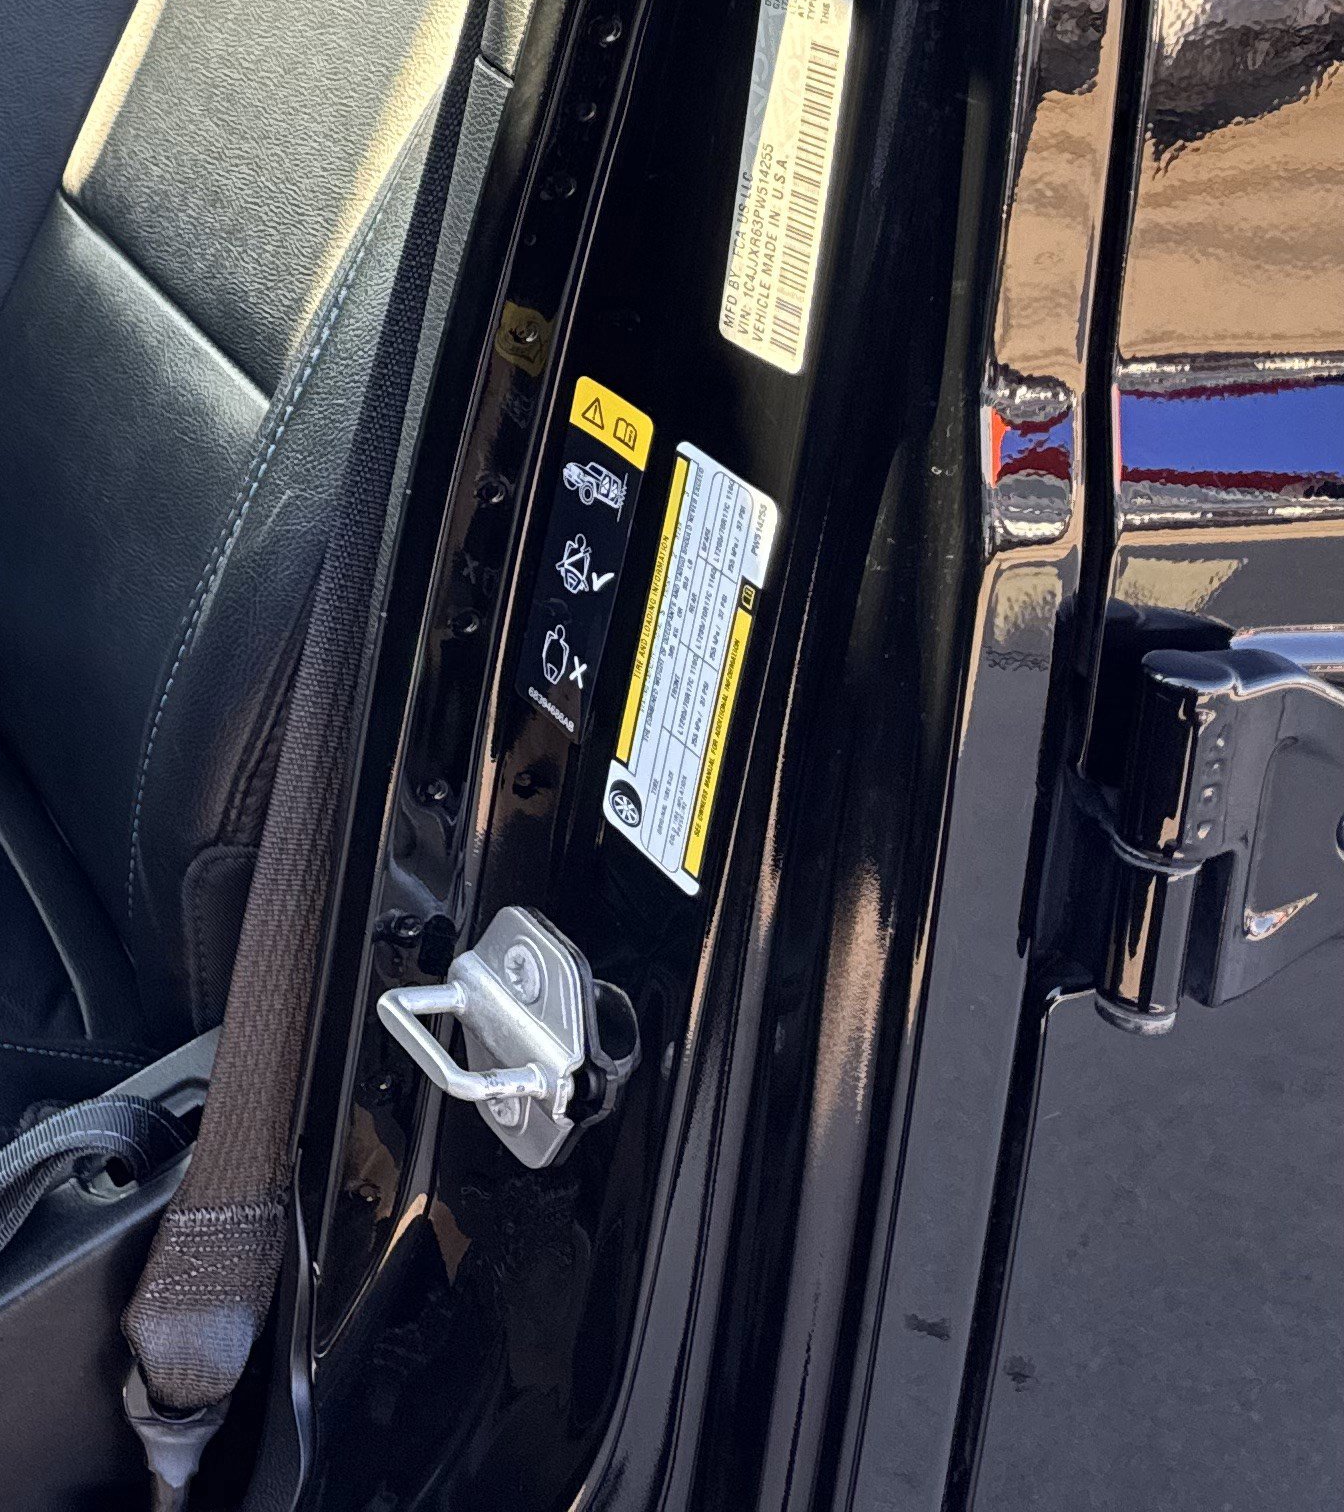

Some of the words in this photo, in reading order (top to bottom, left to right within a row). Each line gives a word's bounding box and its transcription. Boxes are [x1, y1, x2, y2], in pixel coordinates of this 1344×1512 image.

[797, 5, 805, 18] AT
[819, 1, 830, 25] THIS
[739, 169, 753, 200] LLC
[736, 202, 750, 225] US
[742, 140, 774, 301] 1C4JJXR63PW514255
[732, 227, 746, 259] FCA
[760, 230, 778, 277] MADE
[723, 293, 738, 329] MFD
[737, 302, 752, 337] VIN:
[752, 278, 771, 344] VEHICLE
[737, 503, 746, 520] PSI
[700, 525, 711, 553] SPARE
[650, 533, 669, 597] INFORMATION
[671, 582, 680, 600] AND
[687, 591, 697, 615] REAR
[719, 592, 728, 609] PSI
[642, 595, 656, 638] LOADING
[638, 636, 648, 658] AND
[633, 658, 644, 681] TIRE
[723, 636, 740, 693] INFORMATION
[670, 672, 681, 700] FRONT
[701, 679, 709, 696] PSI
[713, 691, 728, 738] ADDITIONAL
[709, 736, 719, 756] FOR
[702, 754, 715, 789] MANUAL
[693, 820, 701, 838] SEE
